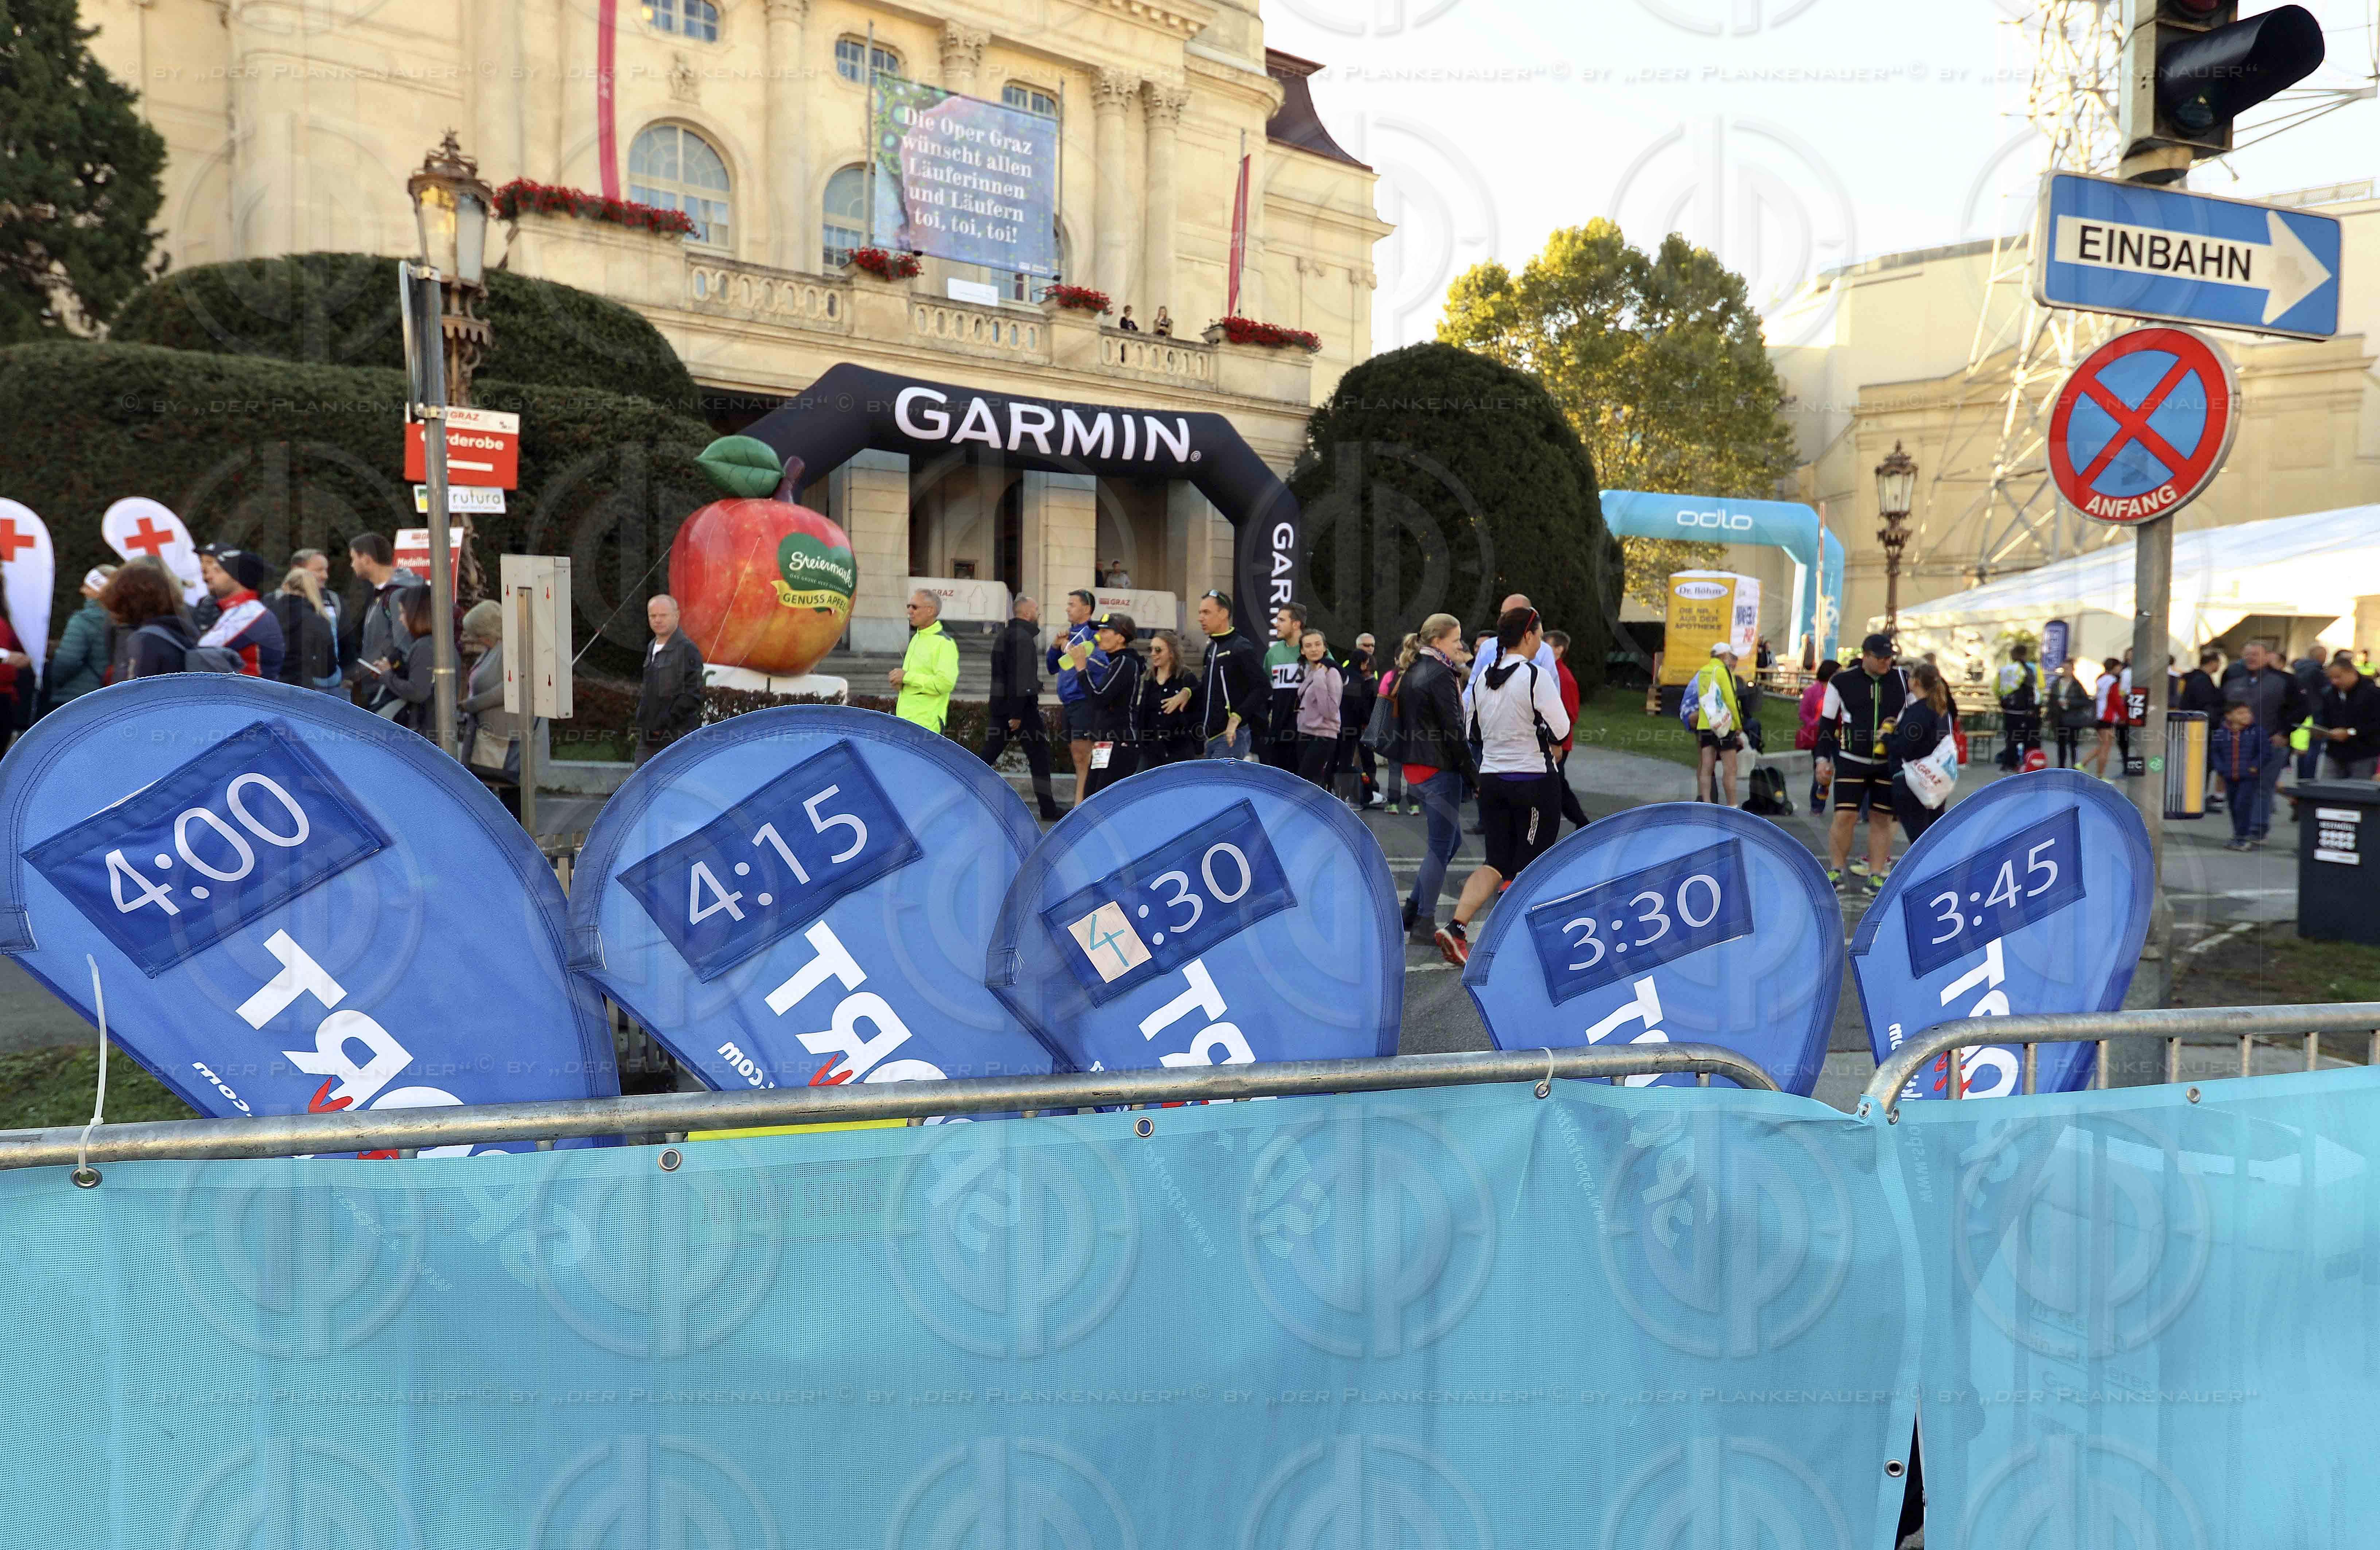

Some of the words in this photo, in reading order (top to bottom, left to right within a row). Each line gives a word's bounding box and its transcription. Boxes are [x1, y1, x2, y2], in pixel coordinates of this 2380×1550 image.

[904, 107, 934, 131] Die
[941, 118, 985, 144] Oper
[989, 131, 1032, 155] Graz
[901, 134, 981, 167] wünscht
[987, 155, 1032, 178] allen
[909, 158, 1026, 200] Läuferinnen
[909, 187, 945, 206] und
[950, 191, 1024, 222] Läufern
[914, 207, 946, 232] toi,
[950, 216, 982, 238] toi,
[987, 223, 1017, 244] toi!
[2078, 225, 2252, 281] EINBAHN
[450, 410, 479, 421] GRAZ
[420, 430, 505, 451] derobe
[452, 490, 501, 505] rutura
[2085, 484, 2177, 518] ANFANG
[1677, 509, 1753, 530] odlo
[789, 551, 852, 588] Steiermark
[1269, 522, 1294, 648] GAR
[783, 593, 825, 604] GENUSS
[827, 595, 846, 610] APFEL
[1272, 668, 1305, 684] FILA
[105, 772, 310, 916] 4:00
[689, 784, 868, 925] 4:15
[1089, 842, 1251, 967] 4:30
[1929, 838, 2059, 945] 3:45
[1562, 874, 1721, 971] 3:30
